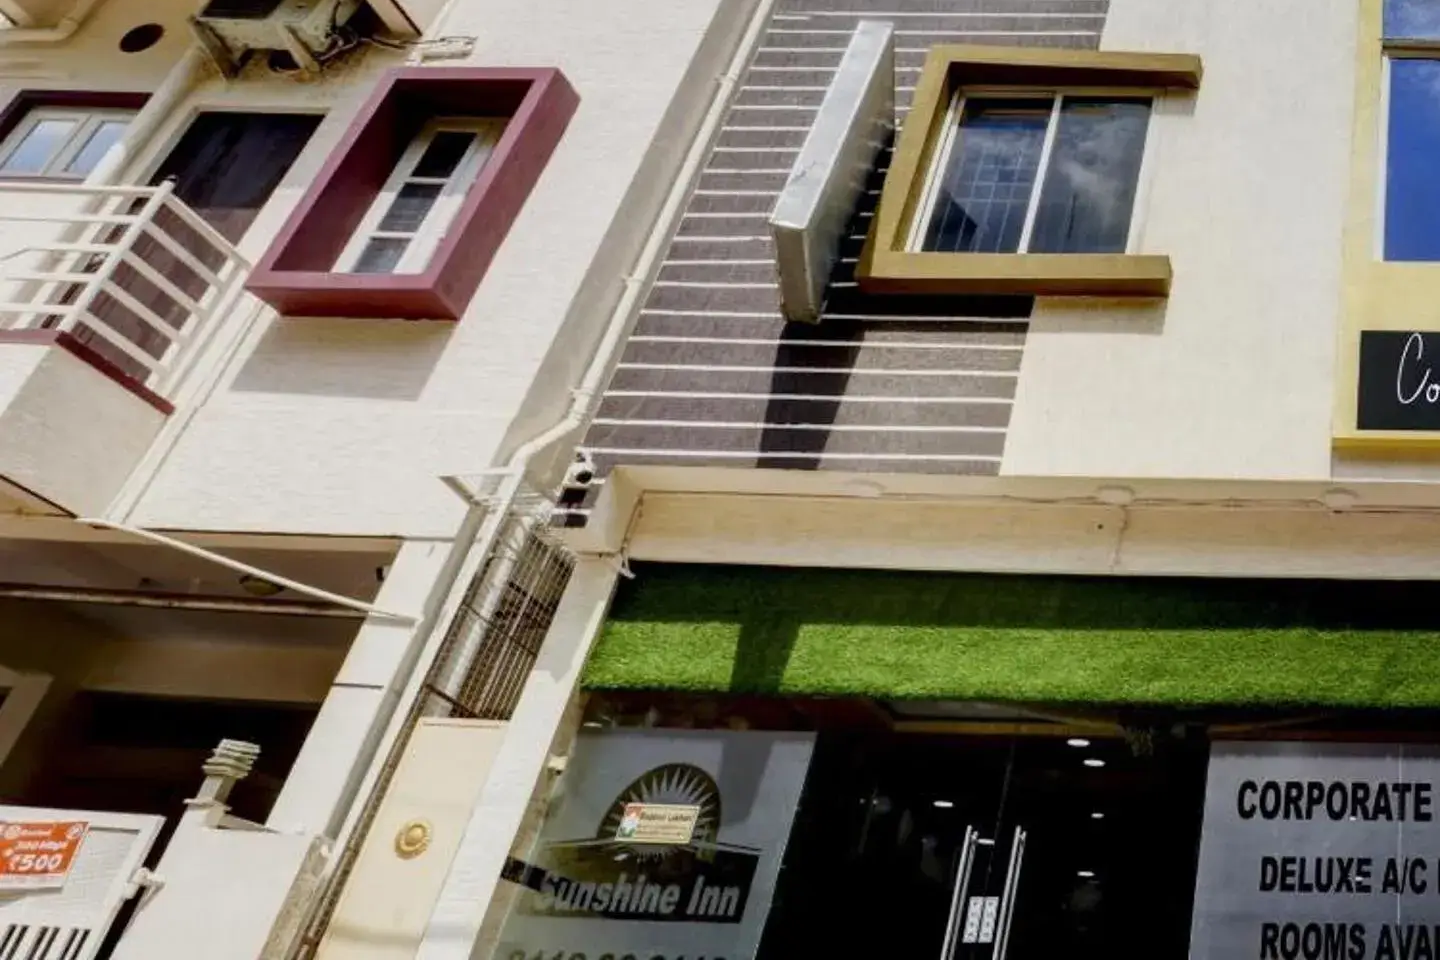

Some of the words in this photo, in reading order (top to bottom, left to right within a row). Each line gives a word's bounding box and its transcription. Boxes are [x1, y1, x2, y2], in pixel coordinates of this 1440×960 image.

[1238, 780, 1432, 822] CORPORATE
[537, 873, 681, 916] Sunshine
[686, 874, 741, 917] Inn
[1259, 856, 1372, 892] DELUXE
[1381, 857, 1428, 895] A/C
[1260, 923, 1366, 960] ROOMS
